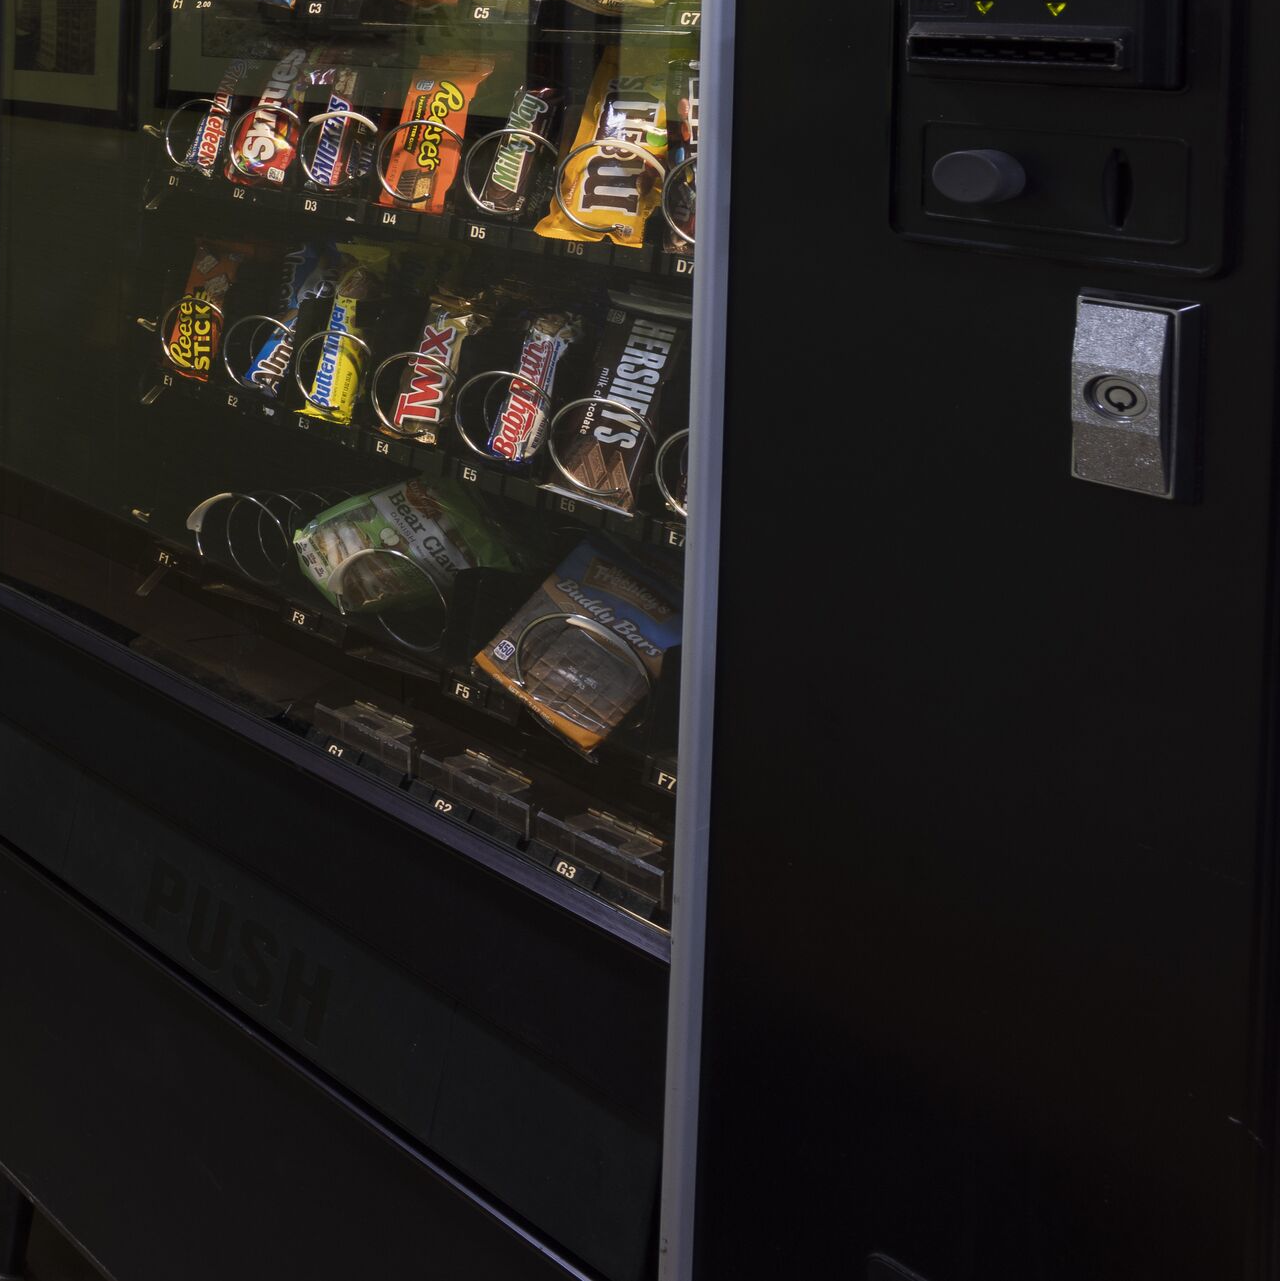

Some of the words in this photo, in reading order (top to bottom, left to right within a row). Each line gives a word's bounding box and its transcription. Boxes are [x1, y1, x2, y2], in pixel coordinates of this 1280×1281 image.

[172, 0, 184, 9] C1
[196, 0, 212, 10] 2.00
[308, 3, 322, 14] C3
[474, 7, 490, 19] C5
[680, 12, 700, 25] C7
[168, 175, 180, 187] D1
[233, 187, 245, 200] D2
[304, 199, 318, 212] D3
[382, 212, 397, 225] D4
[470, 225, 486, 239] D5
[567, 241, 584, 256] D6
[676, 258, 695, 275] D7
[311, 304, 348, 408] Butterfinger
[509, 340, 554, 402] Ruth
[595, 367, 610, 388] milk
[163, 375, 173, 387] E1
[594, 320, 677, 450] HERSHEY'S
[227, 395, 238, 408] E2
[298, 416, 310, 430] E3
[493, 395, 536, 459] Baby
[376, 440, 389, 455] E4
[463, 467, 478, 482] E5
[388, 490, 427, 535] Bear
[559, 498, 576, 513] E6
[390, 511, 417, 543] DANISH
[668, 531, 685, 547] E7
[158, 551, 170, 565] F1
[292, 611, 305, 625] F3
[556, 579, 616, 624] Buddy
[612, 619, 663, 658] Bars
[497, 640, 515, 658] 450
[455, 682, 470, 699] F5
[657, 771, 677, 790] F7
[556, 860, 577, 879] G3
